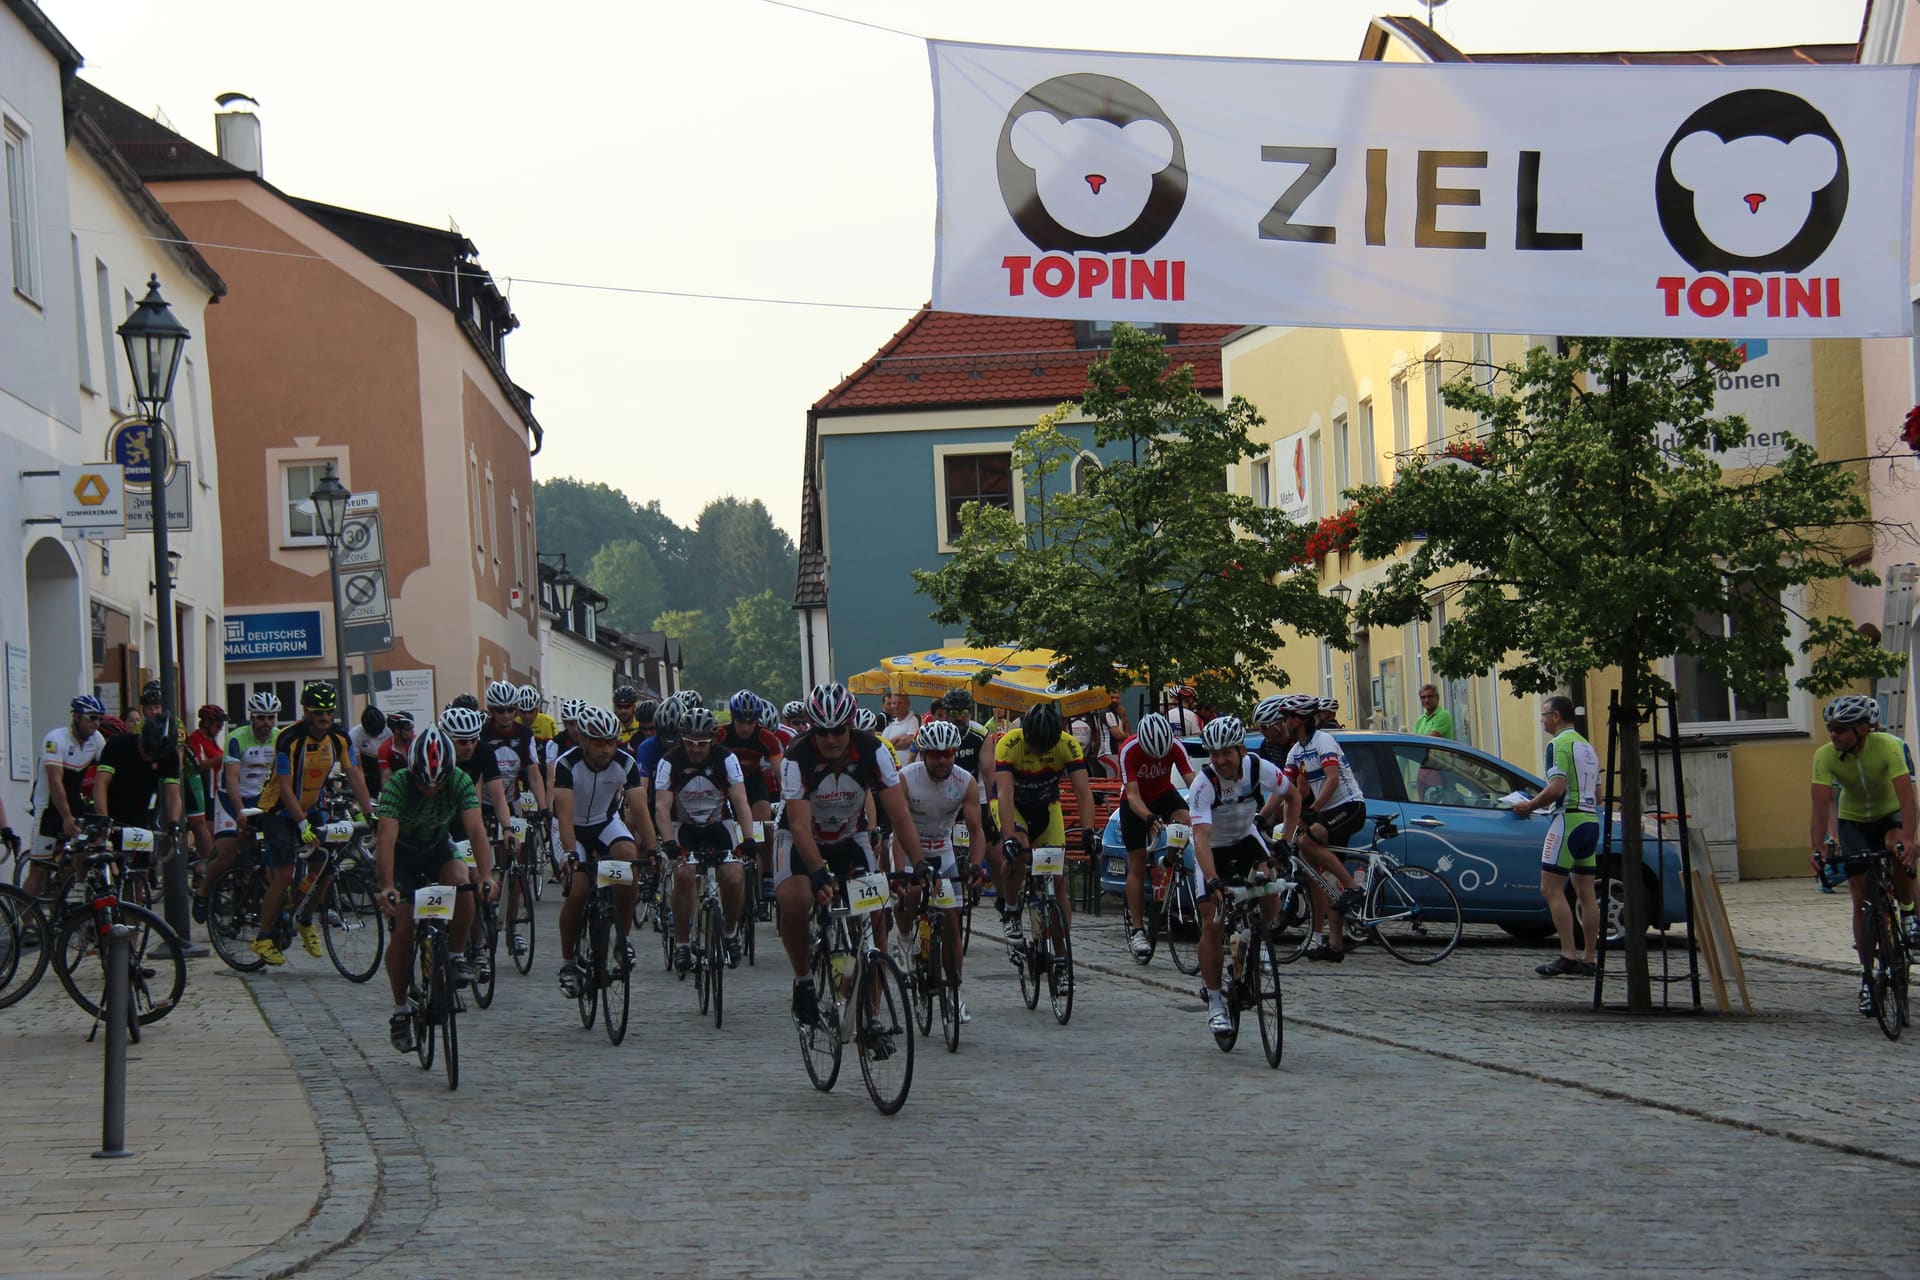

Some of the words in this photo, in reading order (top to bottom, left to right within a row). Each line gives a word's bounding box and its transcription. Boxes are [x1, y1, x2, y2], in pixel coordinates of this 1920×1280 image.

[1258, 146, 1584, 251] ZIEL
[1003, 255, 1185, 301] TOPINI
[1656, 276, 1841, 318] TOPINI
[346, 529, 365, 545] 30
[346, 552, 369, 563] ZONE
[352, 606, 376, 617] ZONE
[248, 629, 306, 641] DEUTSCHES
[224, 641, 307, 656] MAKLERFORUM
[334, 827, 348, 835] 143
[959, 831, 969, 839] 19
[1175, 830, 1184, 839] 18
[1543, 832, 1556, 859] invita
[1045, 856, 1052, 864] 4
[608, 869, 622, 880] 25
[858, 885, 879, 900] 141
[426, 895, 443, 906] 24
